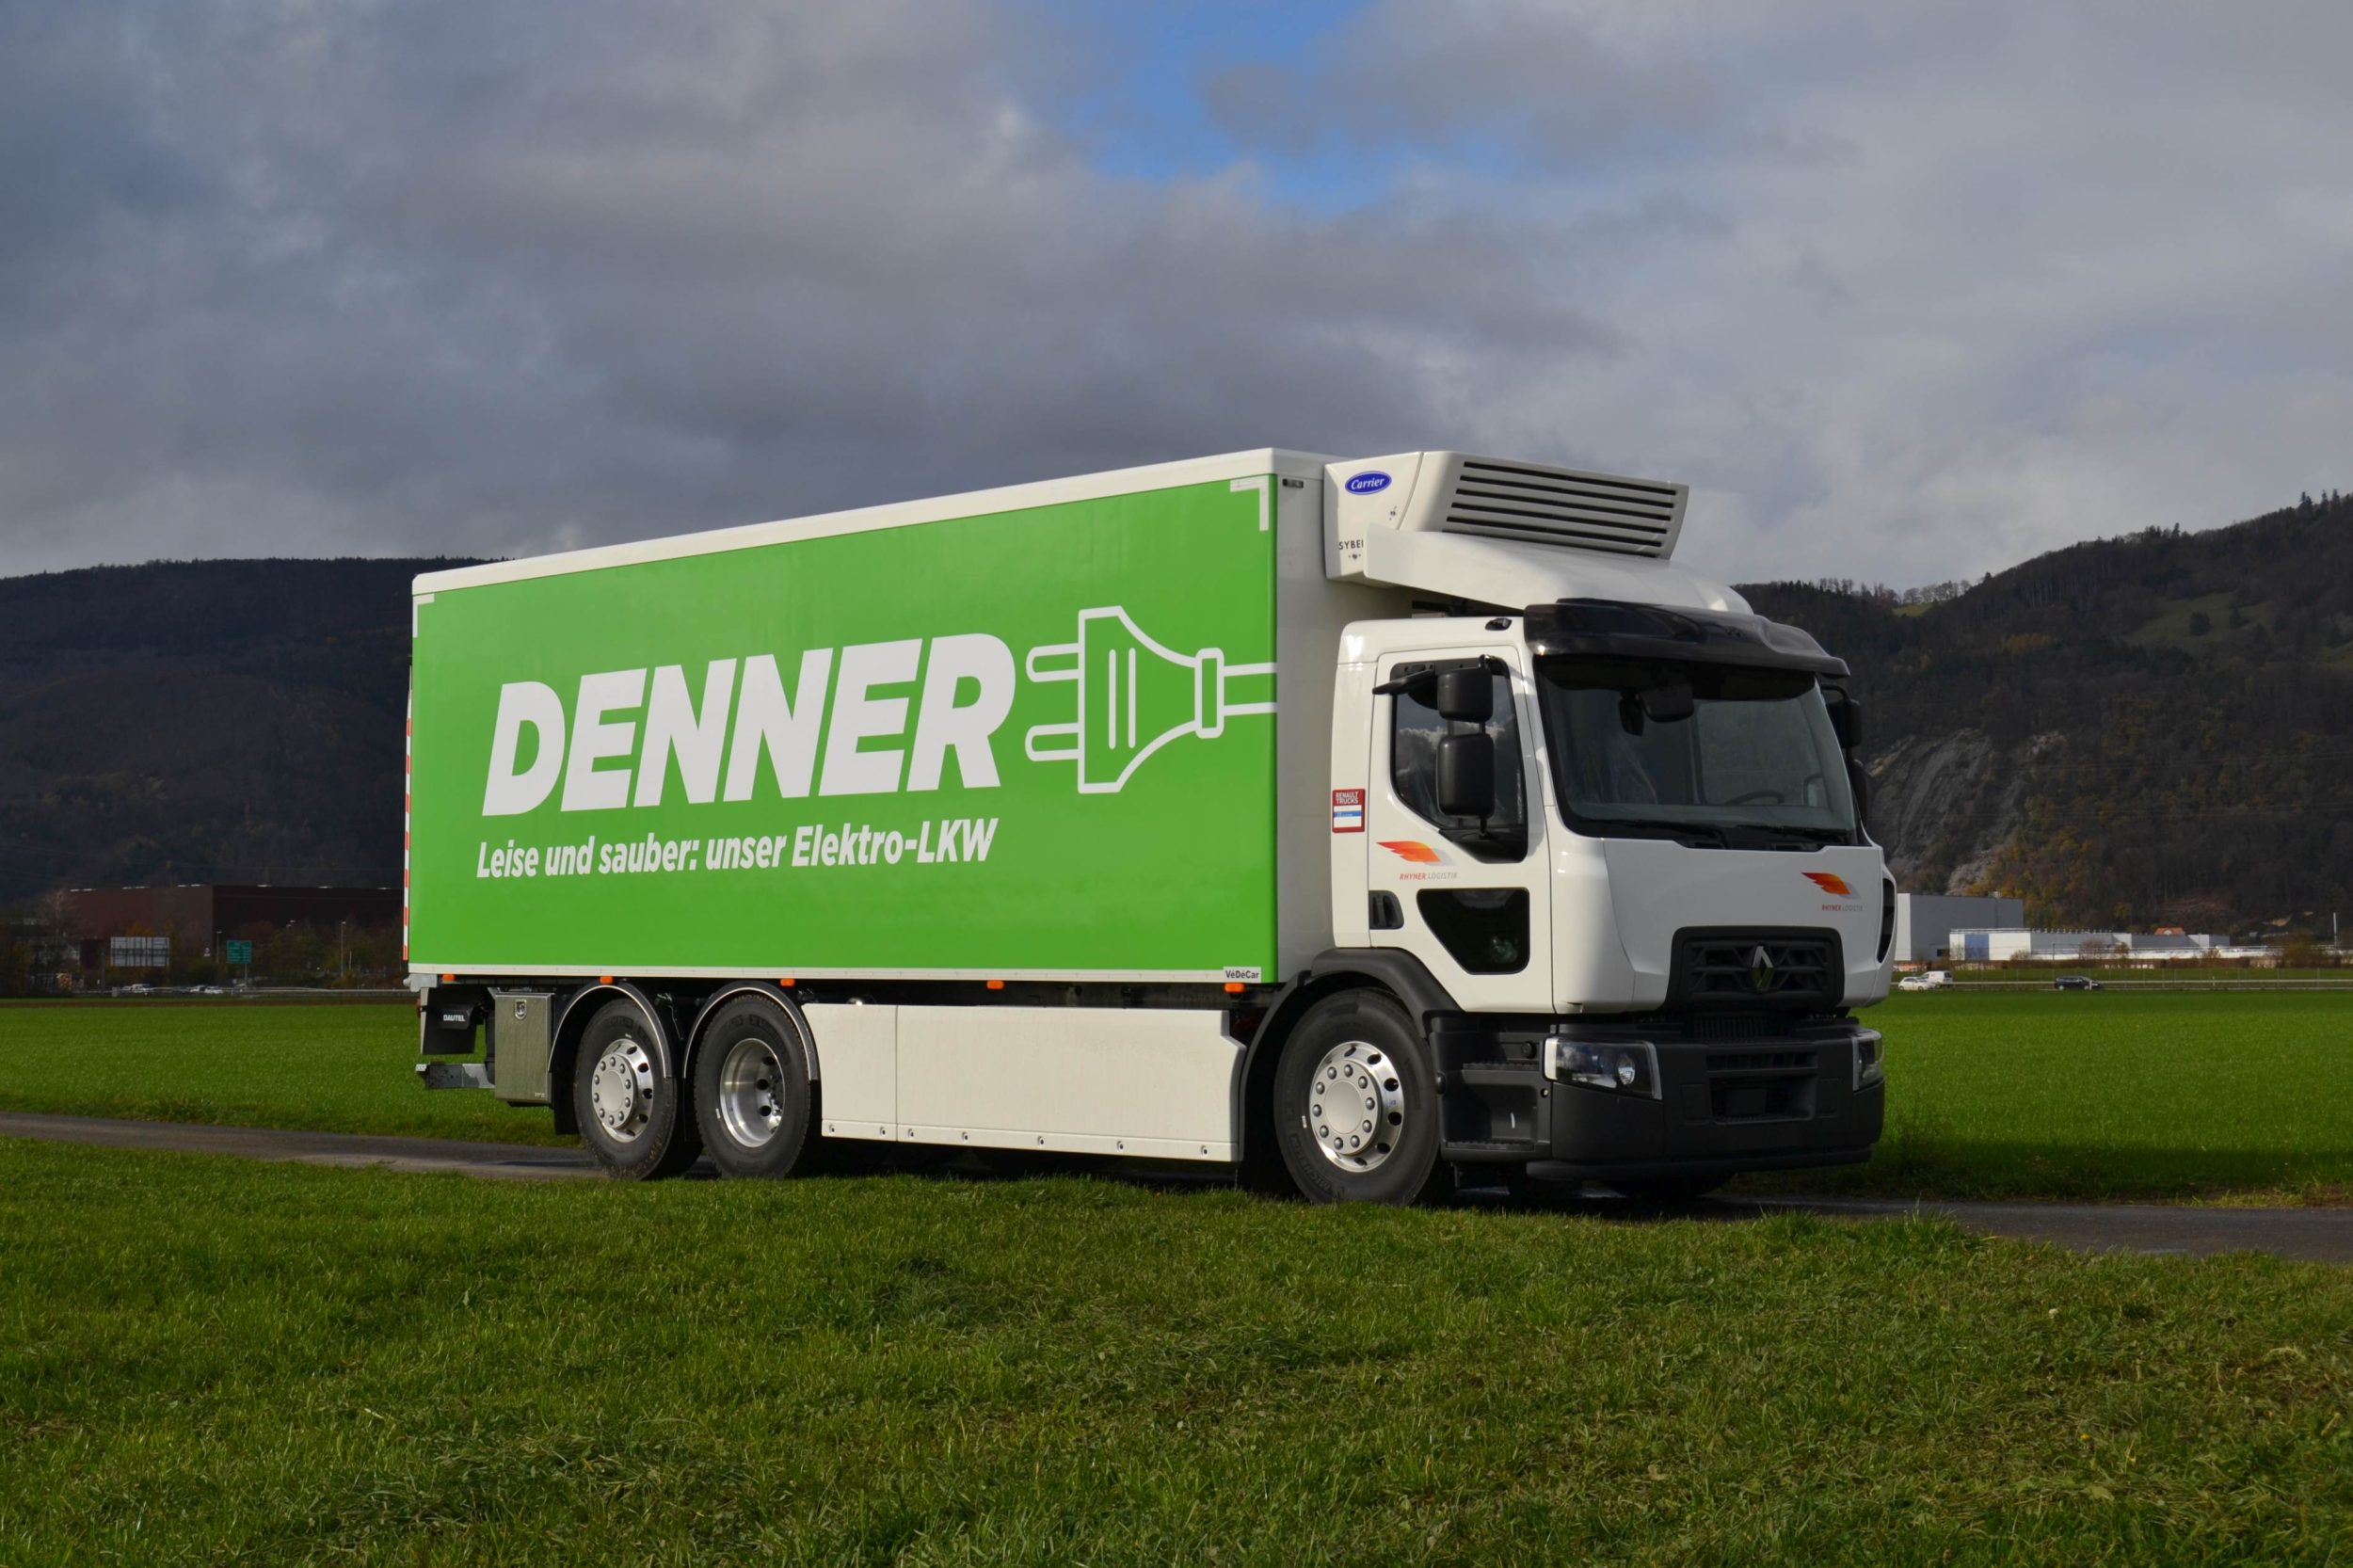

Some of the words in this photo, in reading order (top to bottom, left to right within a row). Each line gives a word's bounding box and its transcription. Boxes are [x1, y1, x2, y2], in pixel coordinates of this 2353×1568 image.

[1352, 477, 1385, 489] Carrier
[1338, 539, 1364, 551] SYBE
[482, 633, 1016, 817] DENNER
[477, 839, 539, 878] Leise
[545, 836, 595, 876] und
[599, 832, 699, 874] sauber:
[706, 836, 787, 870] unser
[792, 818, 999, 867] Elektro-LKW
[1400, 872, 1427, 881] RHYNER
[442, 1014, 466, 1022] DAUTEL
